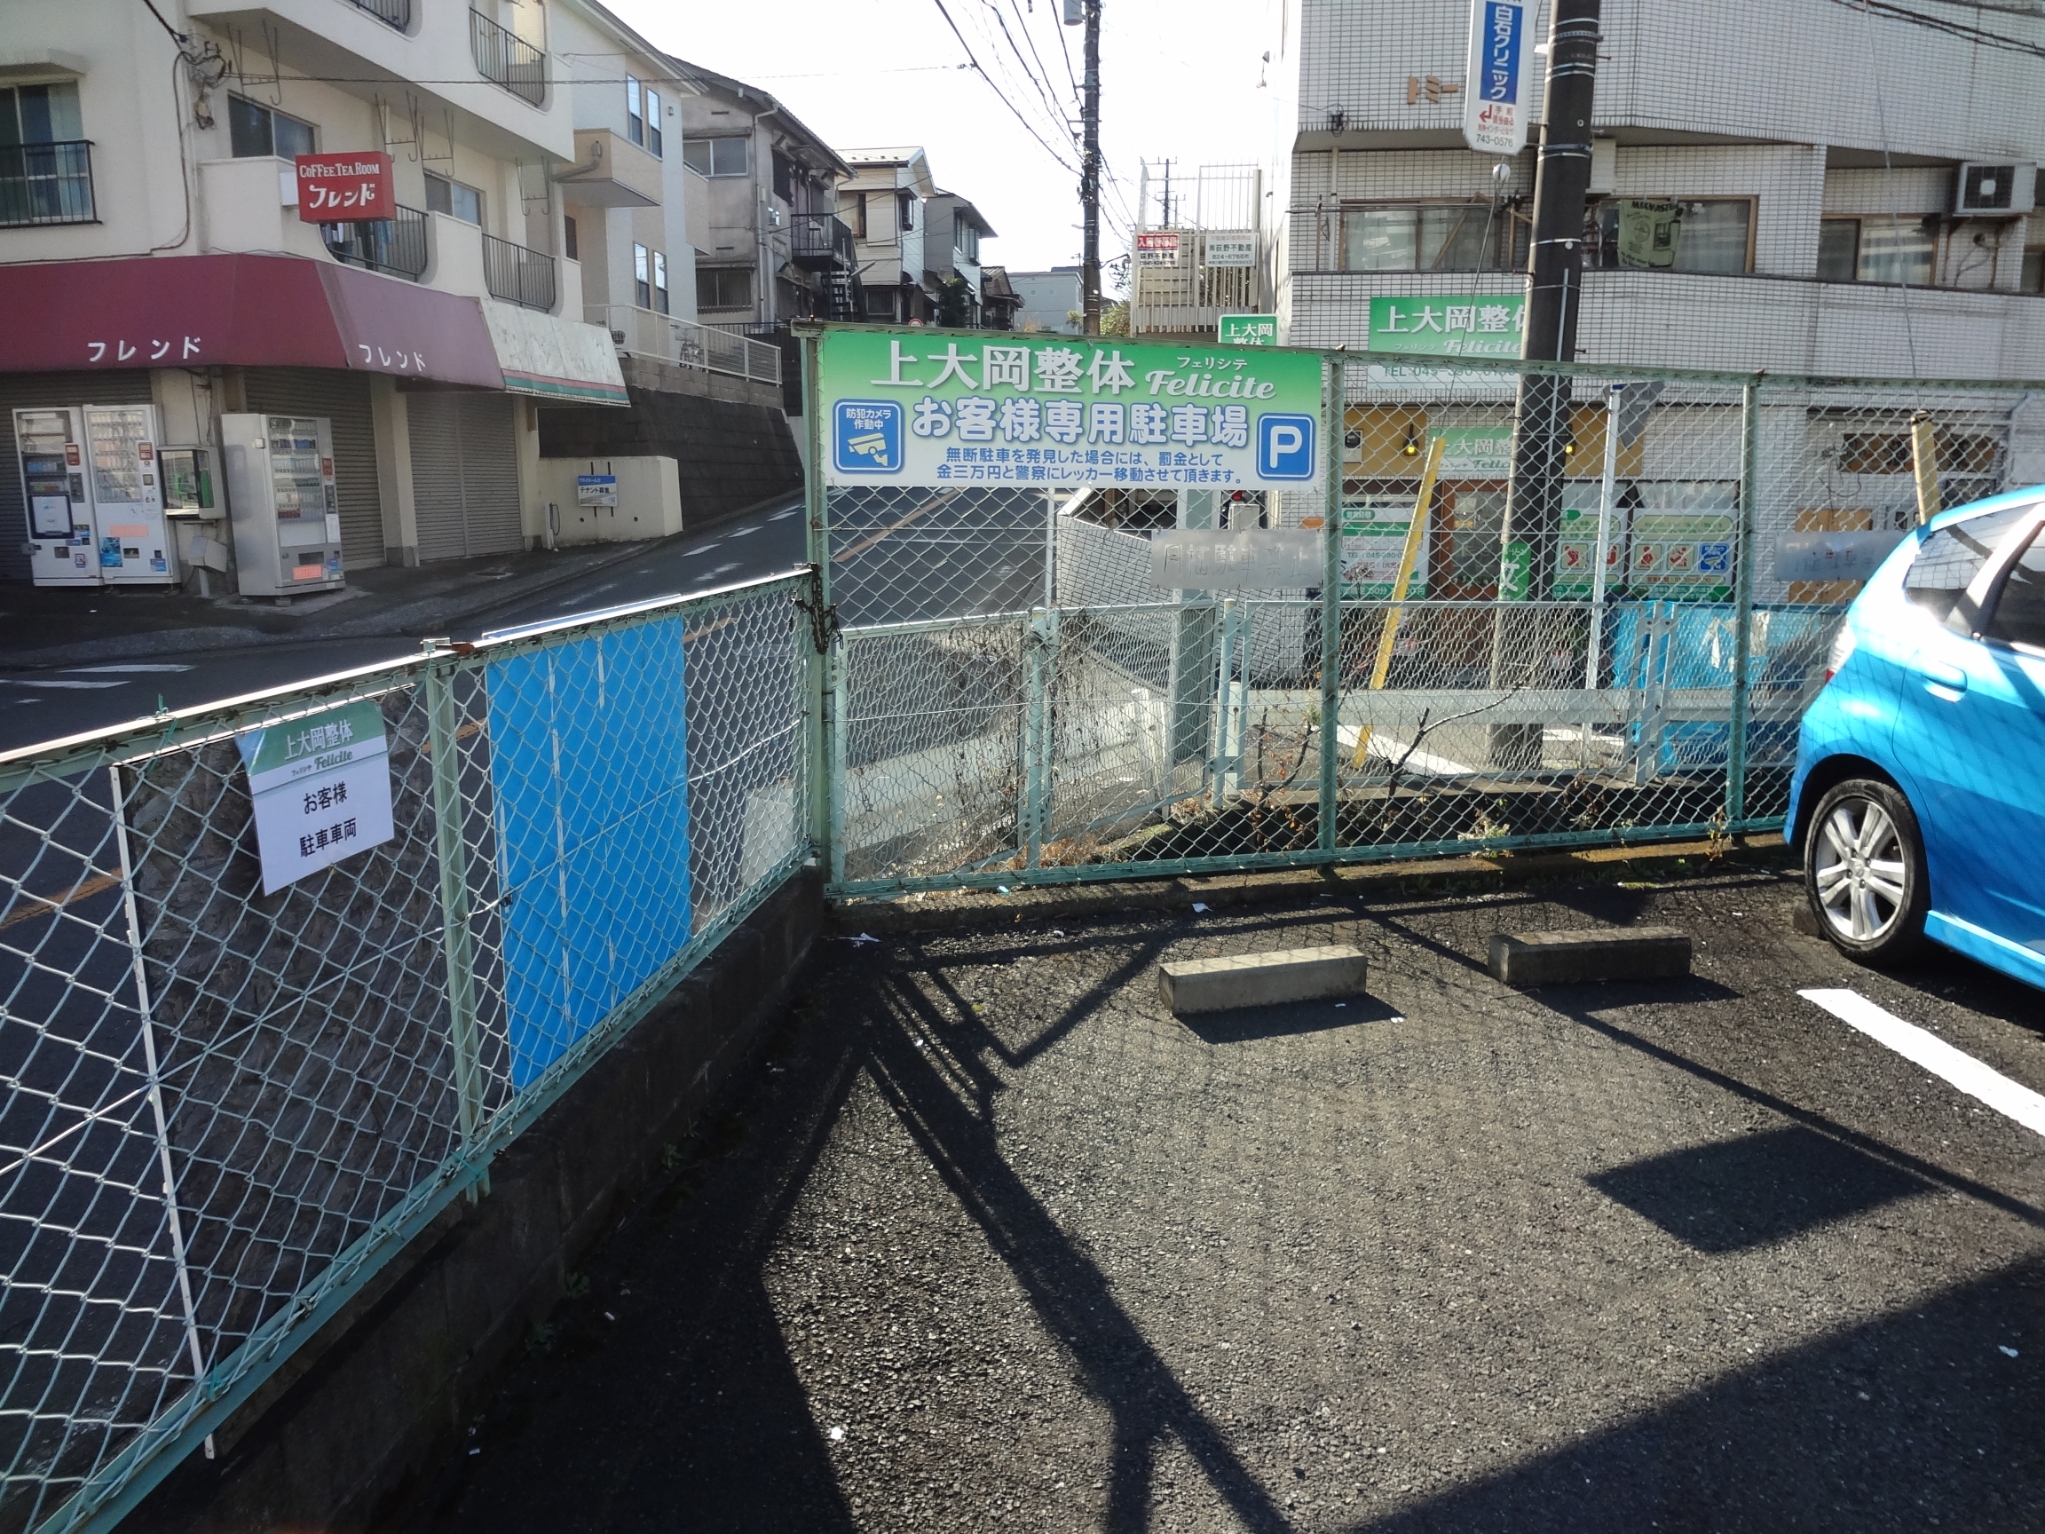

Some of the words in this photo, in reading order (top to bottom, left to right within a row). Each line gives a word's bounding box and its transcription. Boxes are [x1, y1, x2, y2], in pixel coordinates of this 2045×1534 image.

[1490, 6, 1513, 100] 白石クリニック
[1476, 133, 1513, 147] 743-0576
[309, 183, 375, 208] フレンド
[1225, 323, 1273, 337] 上大岡
[88, 336, 201, 362] フレンド
[359, 344, 426, 371] フレンド
[870, 340, 1136, 395] 上大岡整体
[1177, 356, 1248, 371] フェリシテ
[1145, 370, 1277, 401] Felicite
[846, 408, 891, 419] 防犯カメラ
[854, 419, 884, 430] 作動中
[912, 396, 1249, 448] お客様専用駐車場
[946, 447, 1223, 467] 無断駐車を発見した場合には、罰金として
[1269, 425, 1303, 469] P
[937, 464, 1242, 485] 金三万円と警察にレッカー移動させて頂きます。
[285, 718, 354, 761] 上大岡整体
[314, 751, 354, 772] Felicite
[302, 781, 347, 814] お客様
[300, 817, 357, 858] 駐車車両
